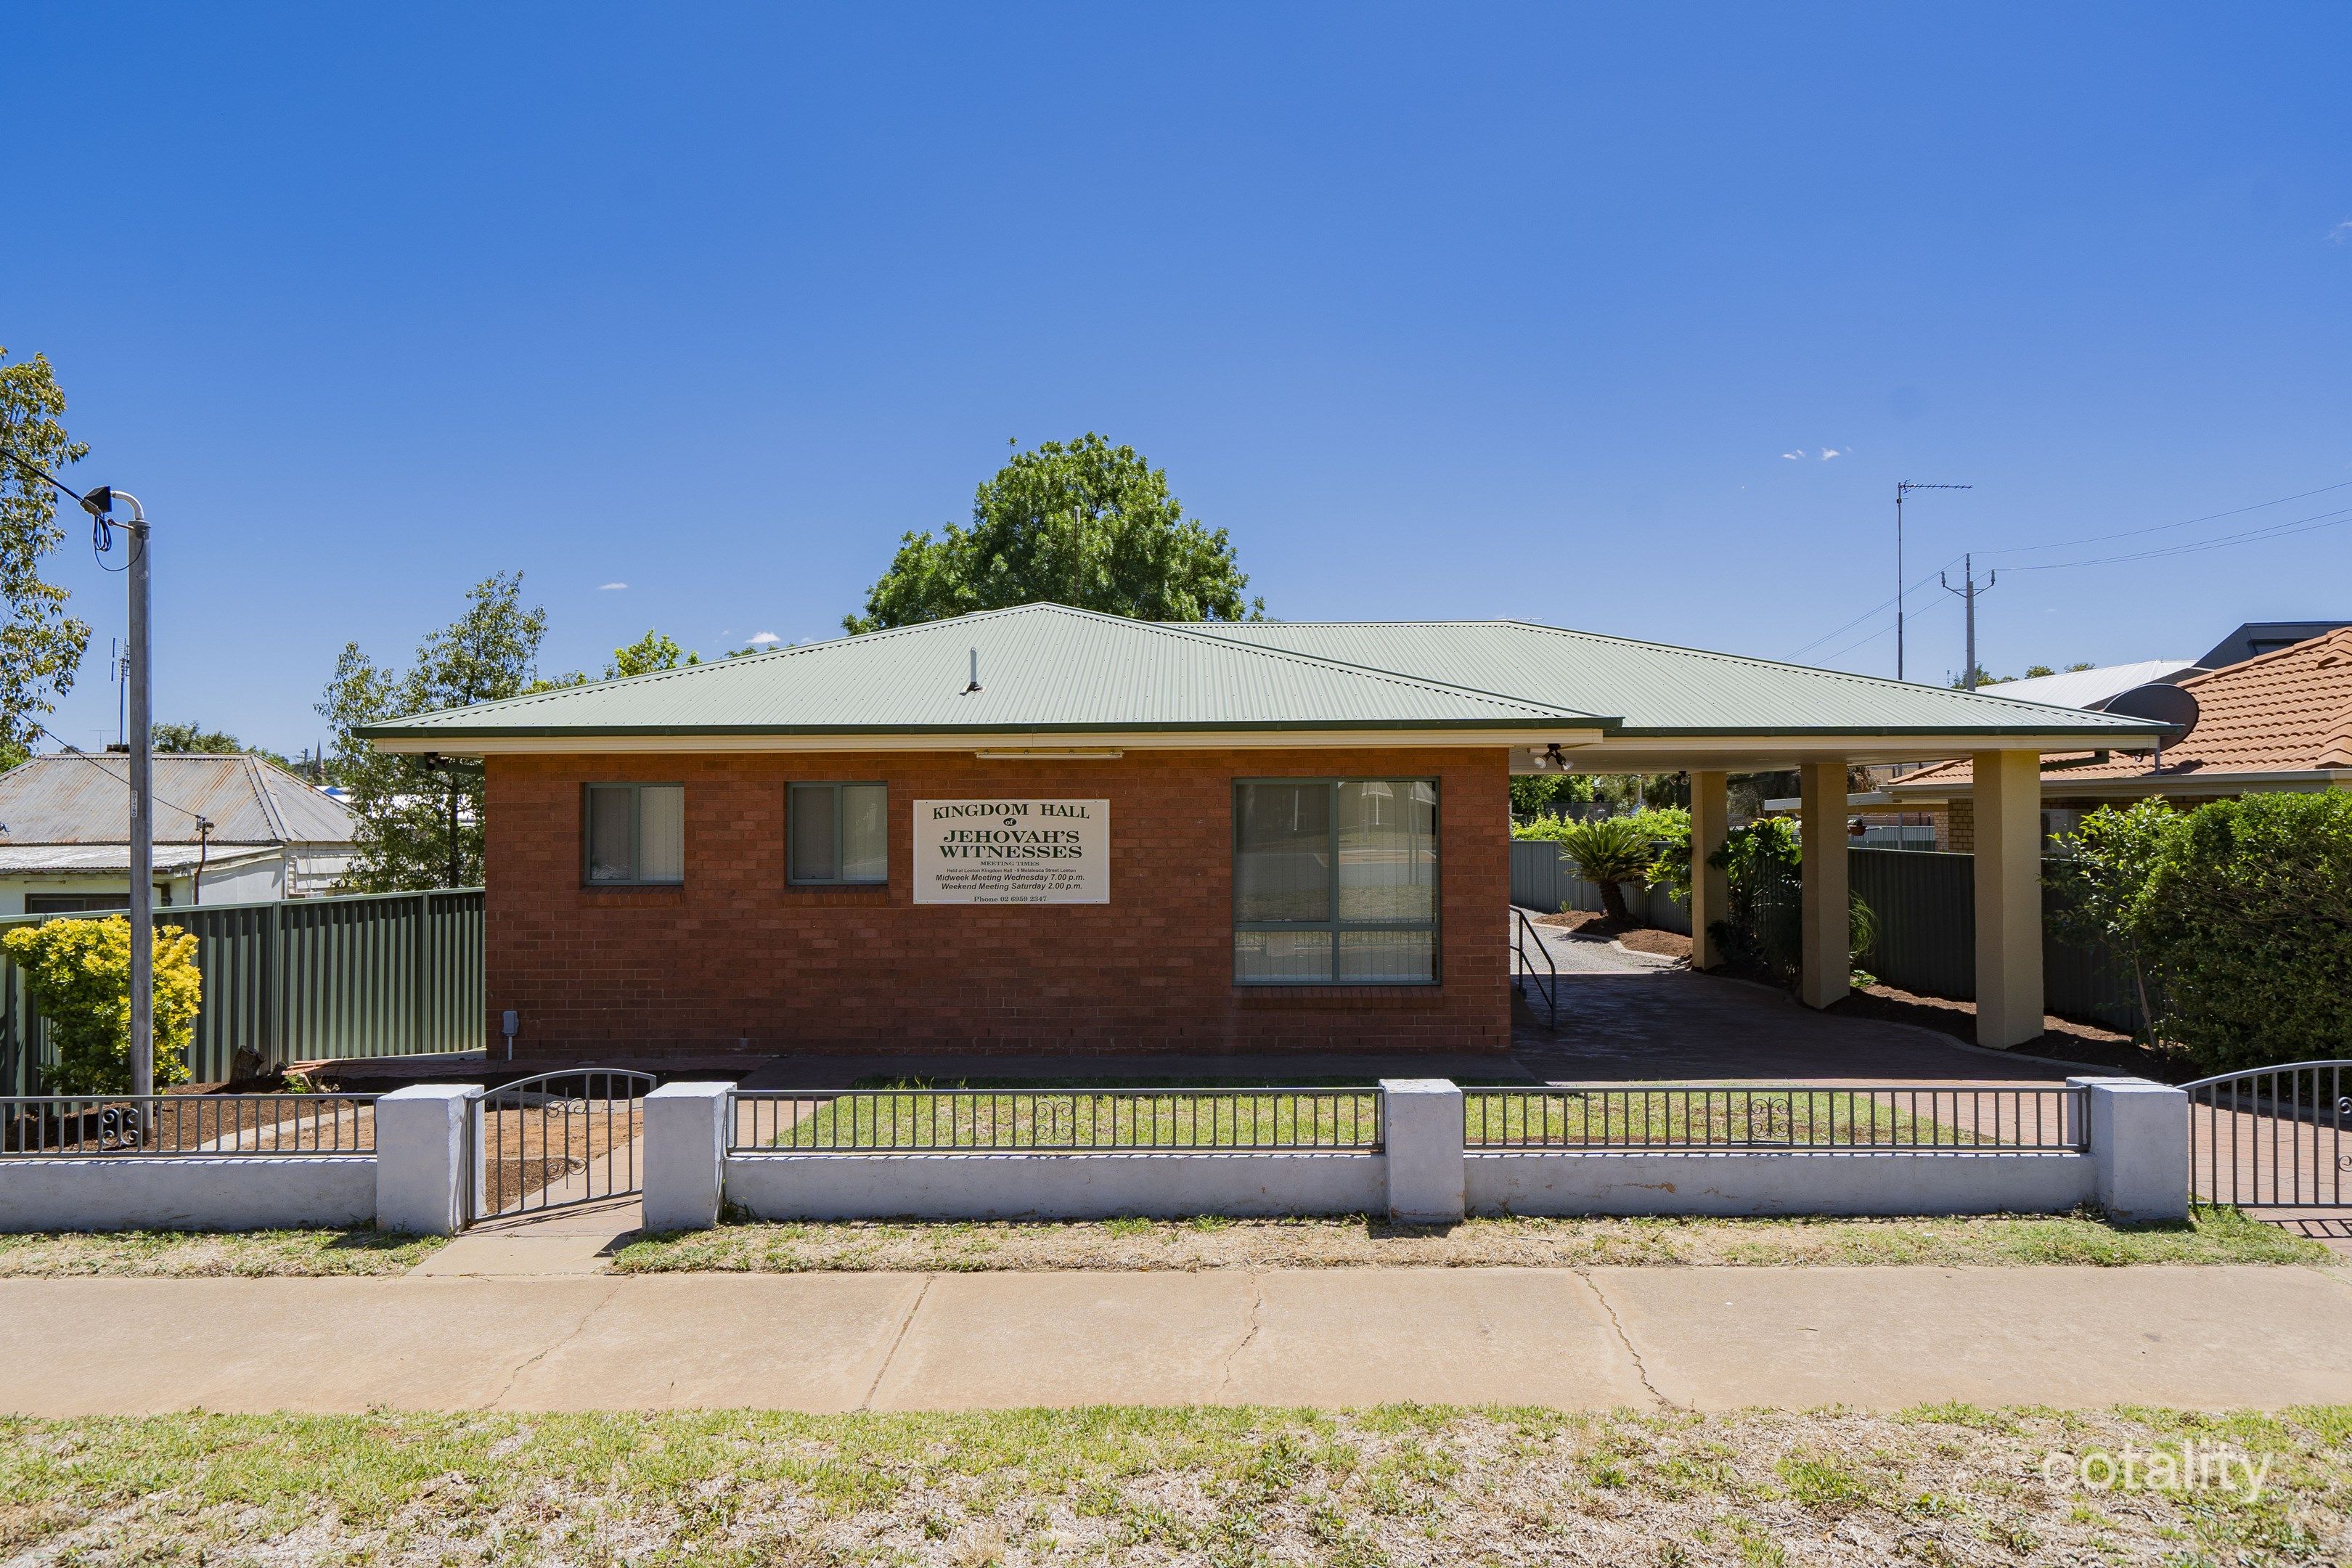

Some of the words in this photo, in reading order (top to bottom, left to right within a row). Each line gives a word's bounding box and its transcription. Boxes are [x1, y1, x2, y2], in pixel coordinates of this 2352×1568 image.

[932, 804, 1029, 820] KINGDOM
[1040, 804, 1090, 820] HALL
[943, 830, 1079, 844] JEHOVAH'S
[939, 846, 1082, 859] WITNESSES
[971, 874, 1002, 883] Meeting
[1003, 873, 1048, 882] Wednesday
[979, 883, 1009, 891] Meeting
